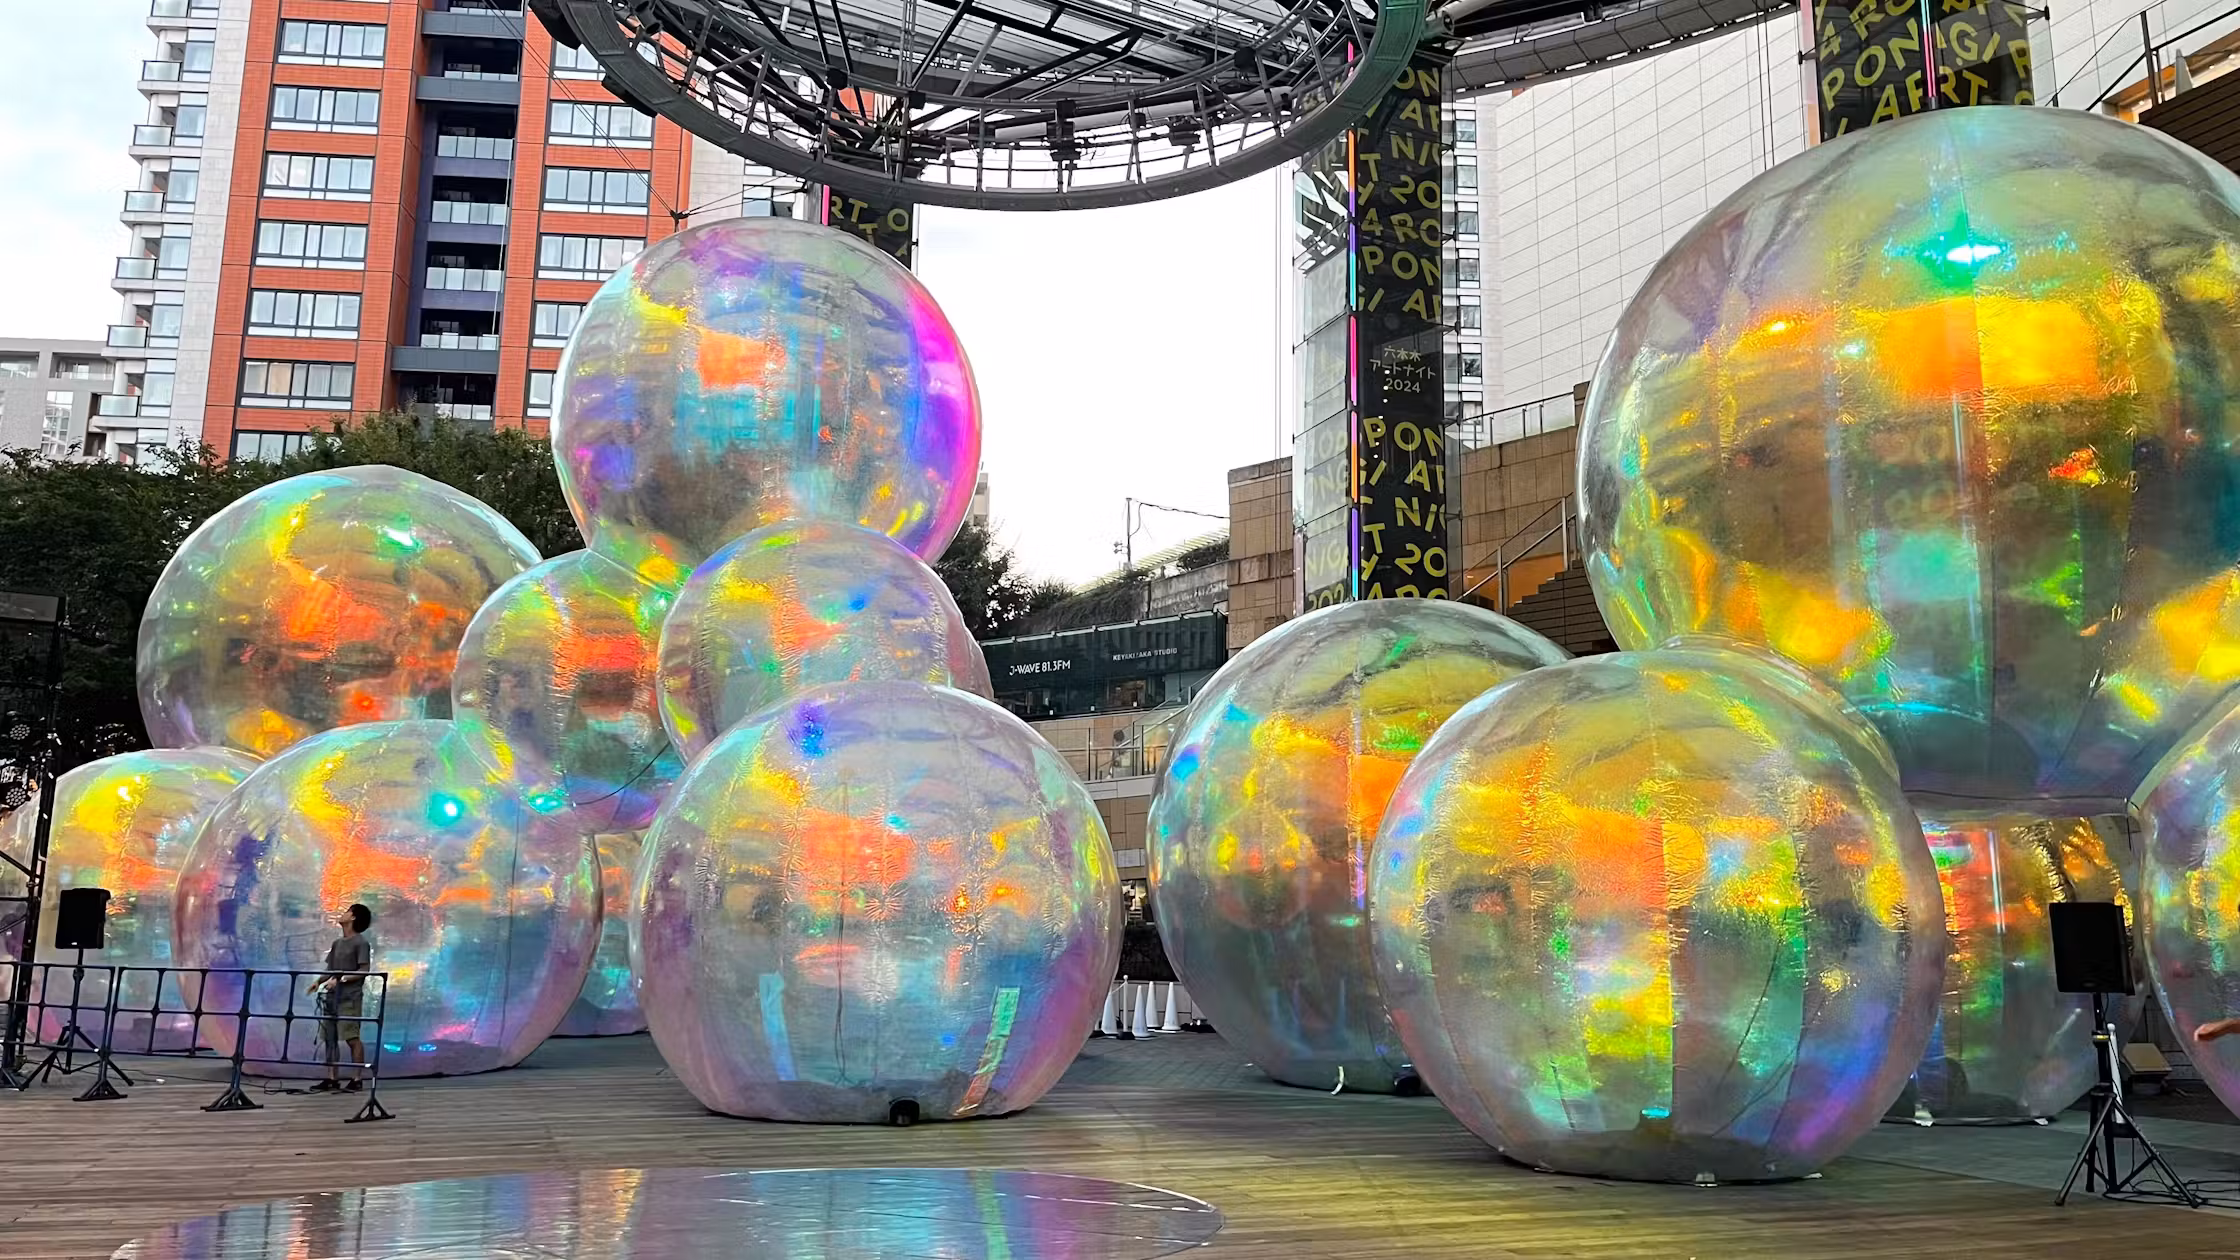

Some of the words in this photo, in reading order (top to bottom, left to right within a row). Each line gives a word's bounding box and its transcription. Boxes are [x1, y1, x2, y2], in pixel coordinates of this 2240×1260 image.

[1369, 359, 1436, 379] アートナイト
[1386, 378, 1421, 393] 2024
[1009, 662, 1040, 676] J-WAVE
[1041, 659, 1071, 673] 81.3FM
